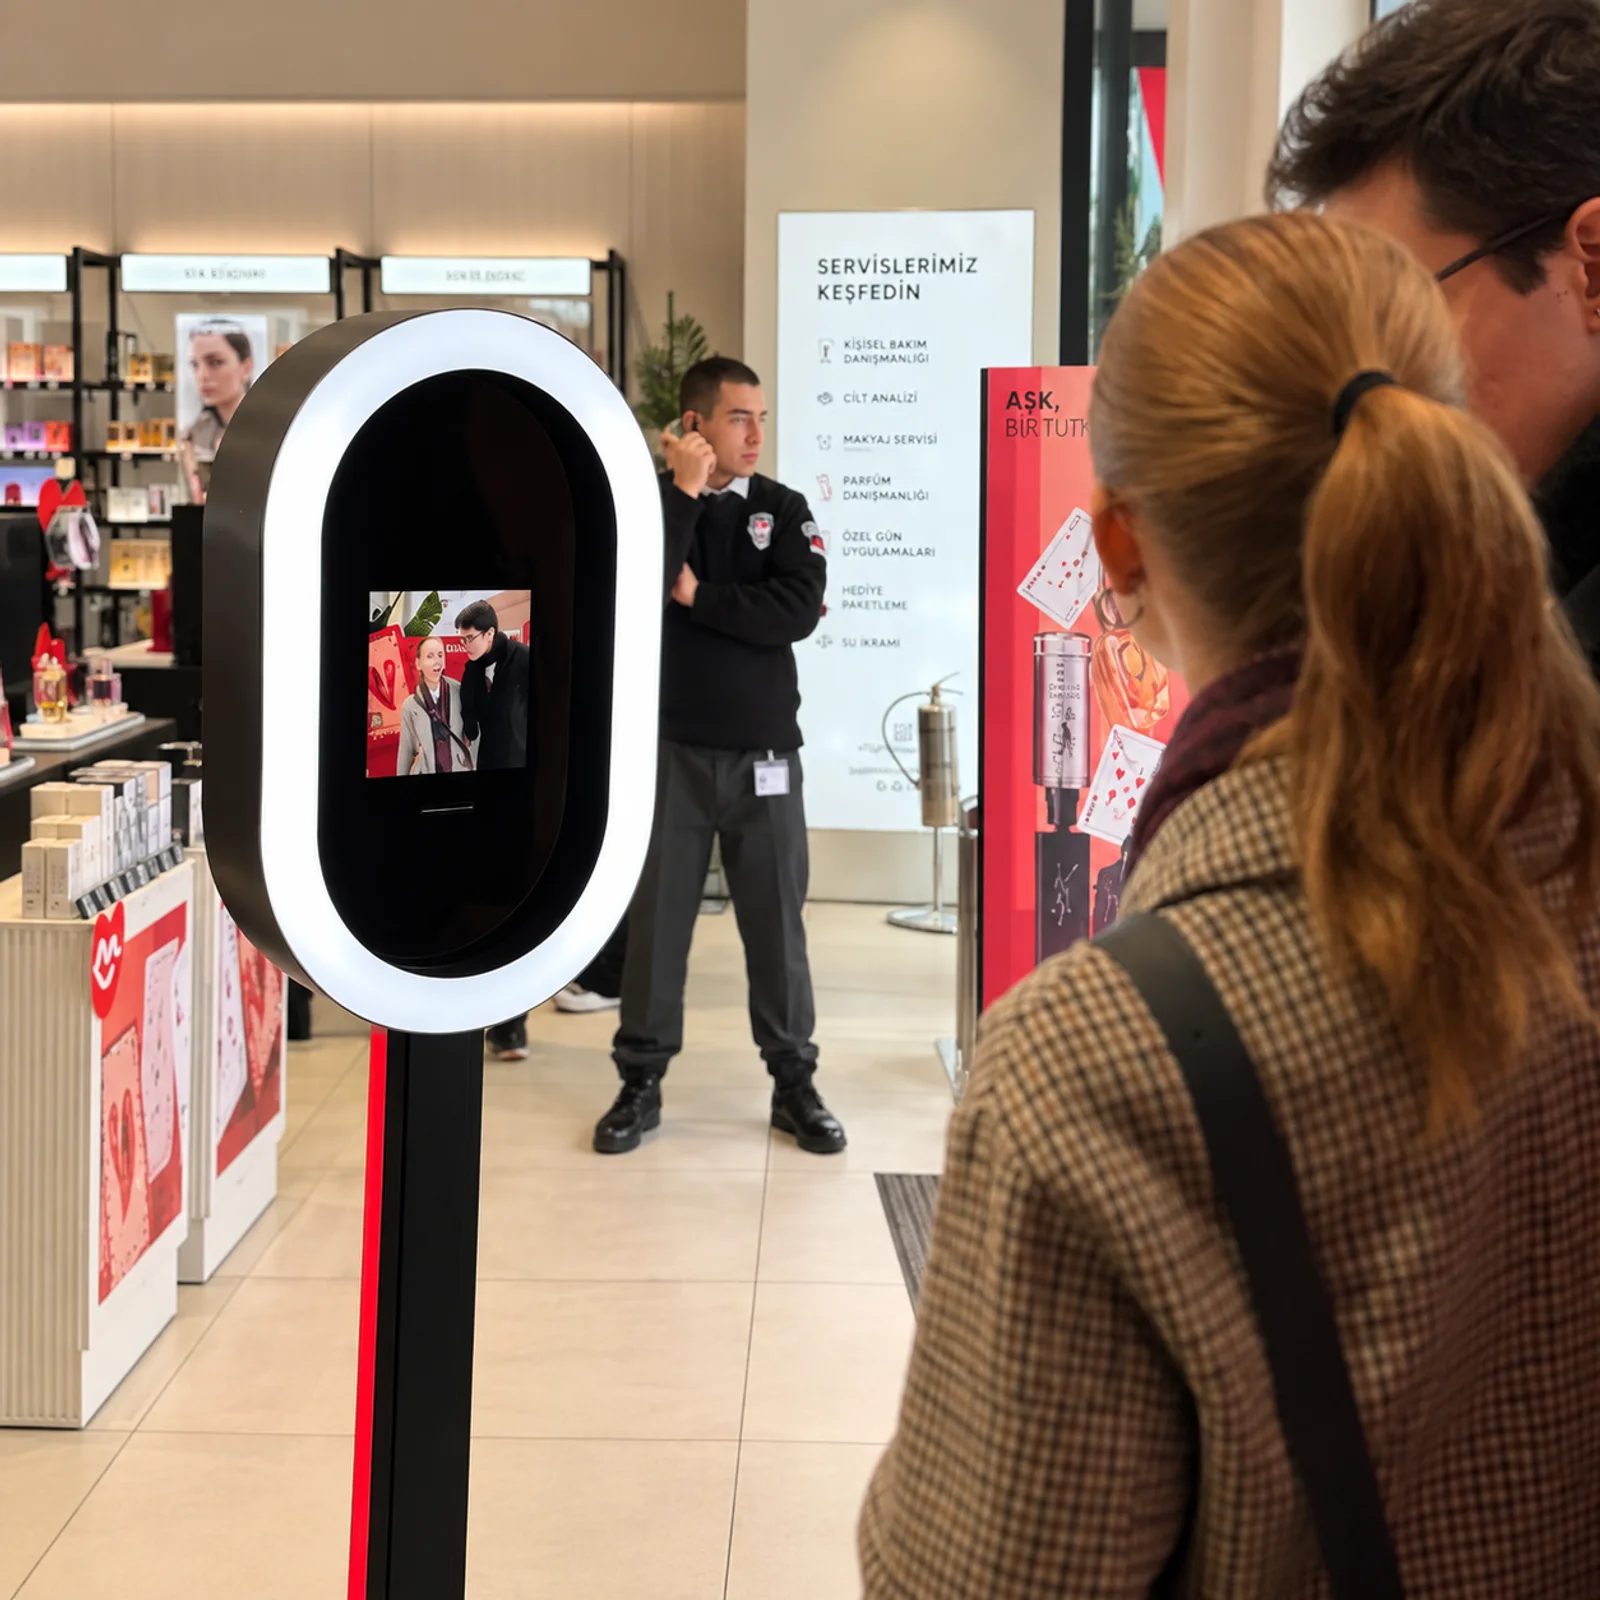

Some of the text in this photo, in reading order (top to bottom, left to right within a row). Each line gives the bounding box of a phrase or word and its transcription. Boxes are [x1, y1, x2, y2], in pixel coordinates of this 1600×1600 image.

[817, 253, 978, 275] SERVİSLERİMİZ
[817, 279, 920, 304] KEŞFEDİN
[843, 337, 928, 351] KİŞİSEL BAKIM
[843, 352, 929, 366] DANIŞMANLIĞI
[843, 390, 918, 403] CİLT ANALİZİ
[1005, 391, 1060, 416] AŞK,
[1005, 413, 1038, 438] BİR
[843, 432, 938, 445] MAKYAJ SERVİSİ
[843, 473, 892, 486] PARFÜM
[842, 489, 929, 502] DANIŞMANLIĞI
[842, 529, 903, 542] ÖZEL GÜN
[842, 583, 884, 596] HEDİYE
[841, 600, 908, 611] PAKETLEME
[841, 637, 857, 648] SU
